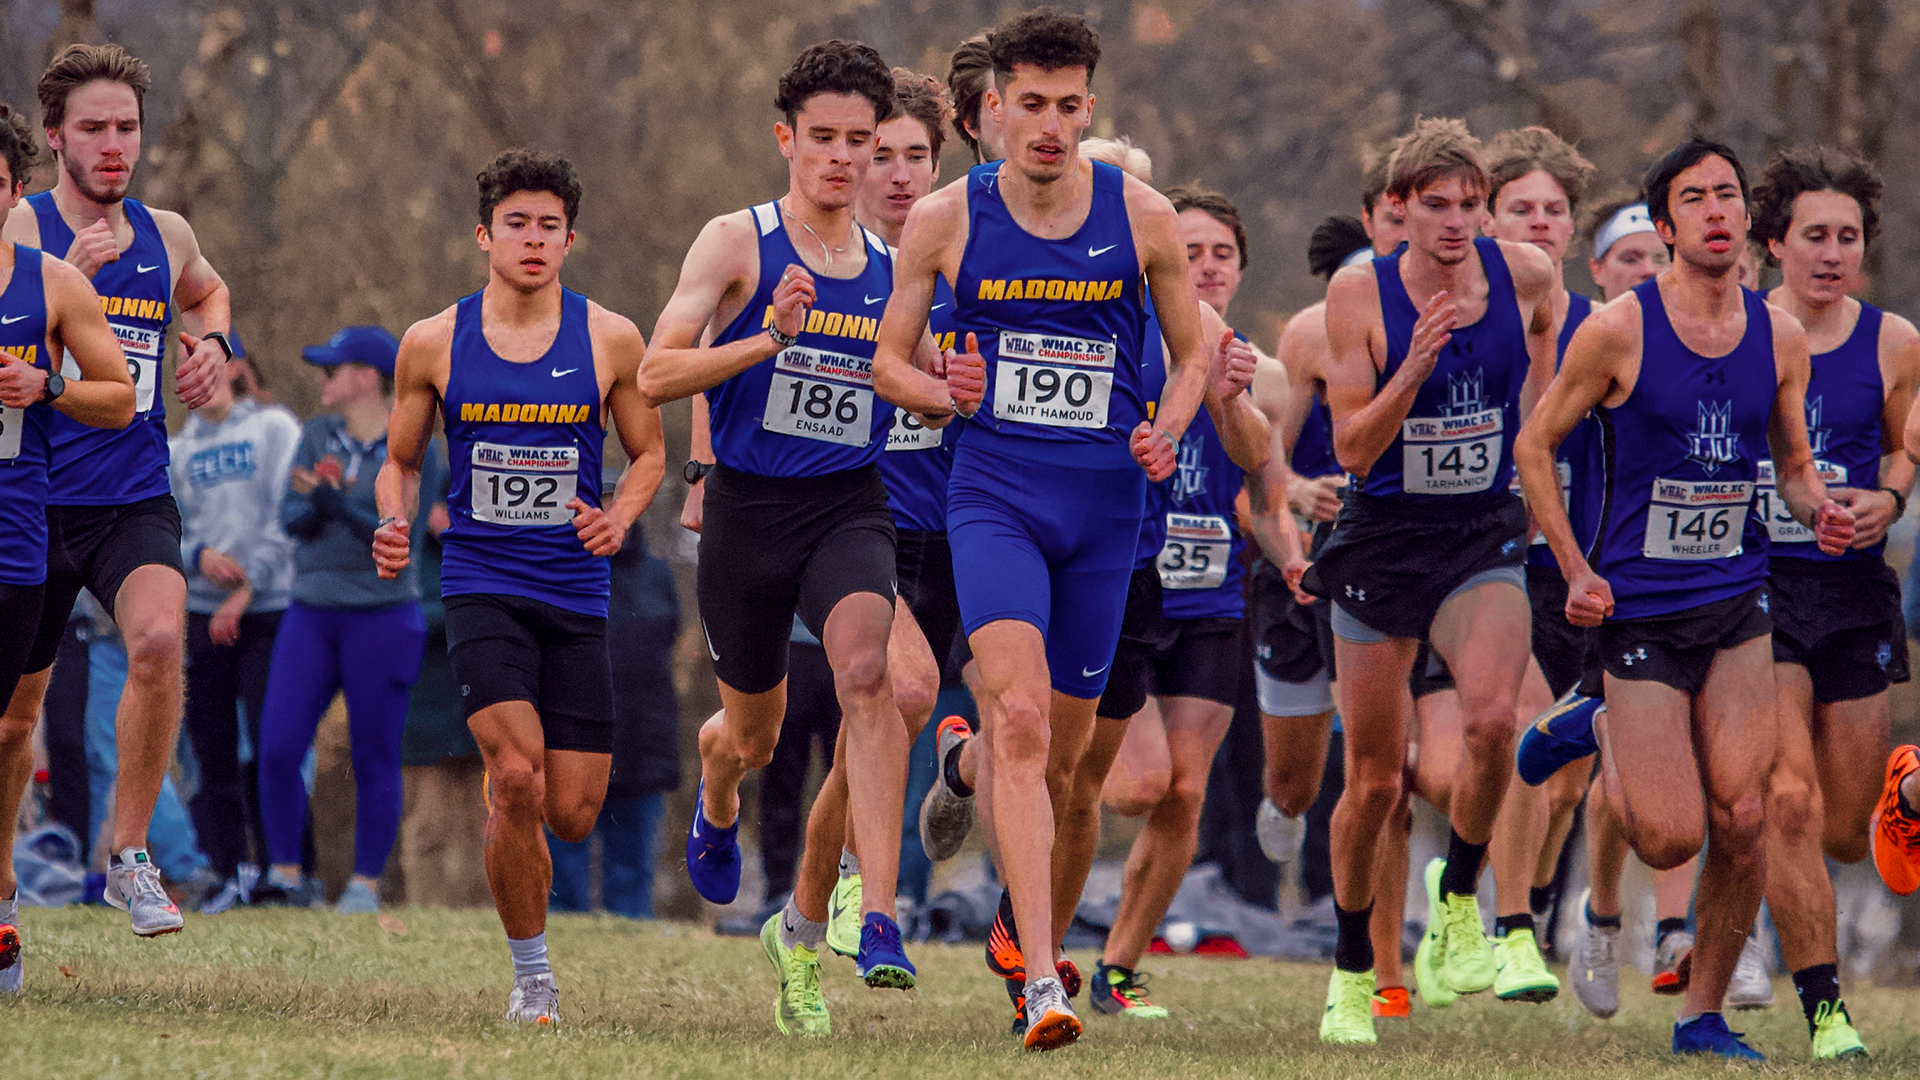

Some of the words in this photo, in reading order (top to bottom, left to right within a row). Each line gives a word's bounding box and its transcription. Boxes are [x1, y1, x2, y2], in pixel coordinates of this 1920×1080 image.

[978, 279, 1123, 301] MADONNA
[137, 332, 151, 343] XC
[1005, 337, 1034, 353] WHAC
[1041, 338, 1082, 352] WHAC
[1085, 343, 1105, 354] XC
[784, 351, 812, 368] WHAC
[819, 354, 853, 369] WHAC
[857, 360, 872, 373] XC
[1038, 349, 1106, 363] CHAMPIONSHIP
[815, 365, 872, 381] CHAMPIONSHIP
[1015, 367, 1092, 407] 190
[789, 380, 859, 425] 186
[460, 403, 590, 423] MADONNA
[1007, 404, 1036, 416] NAIT
[1040, 408, 1093, 421] HAMOUD
[1442, 417, 1478, 428] WHAC
[1480, 413, 1494, 423] XC
[796, 419, 844, 437] ENSAAD
[477, 448, 503, 463] WHAC
[509, 449, 548, 460] WHAC
[552, 451, 569, 460] XC
[1421, 442, 1489, 477] 143
[507, 459, 569, 468] CHAMPIONSHIP
[1425, 476, 1487, 489] TARHANICH
[1694, 485, 1727, 494] WHAC
[1730, 484, 1745, 492] XC
[488, 475, 558, 508] 192
[495, 509, 550, 520] WILLIAMS
[1667, 509, 1729, 542] 146
[1778, 527, 1808, 536] GRAY
[1672, 544, 1720, 555] WHEELER
